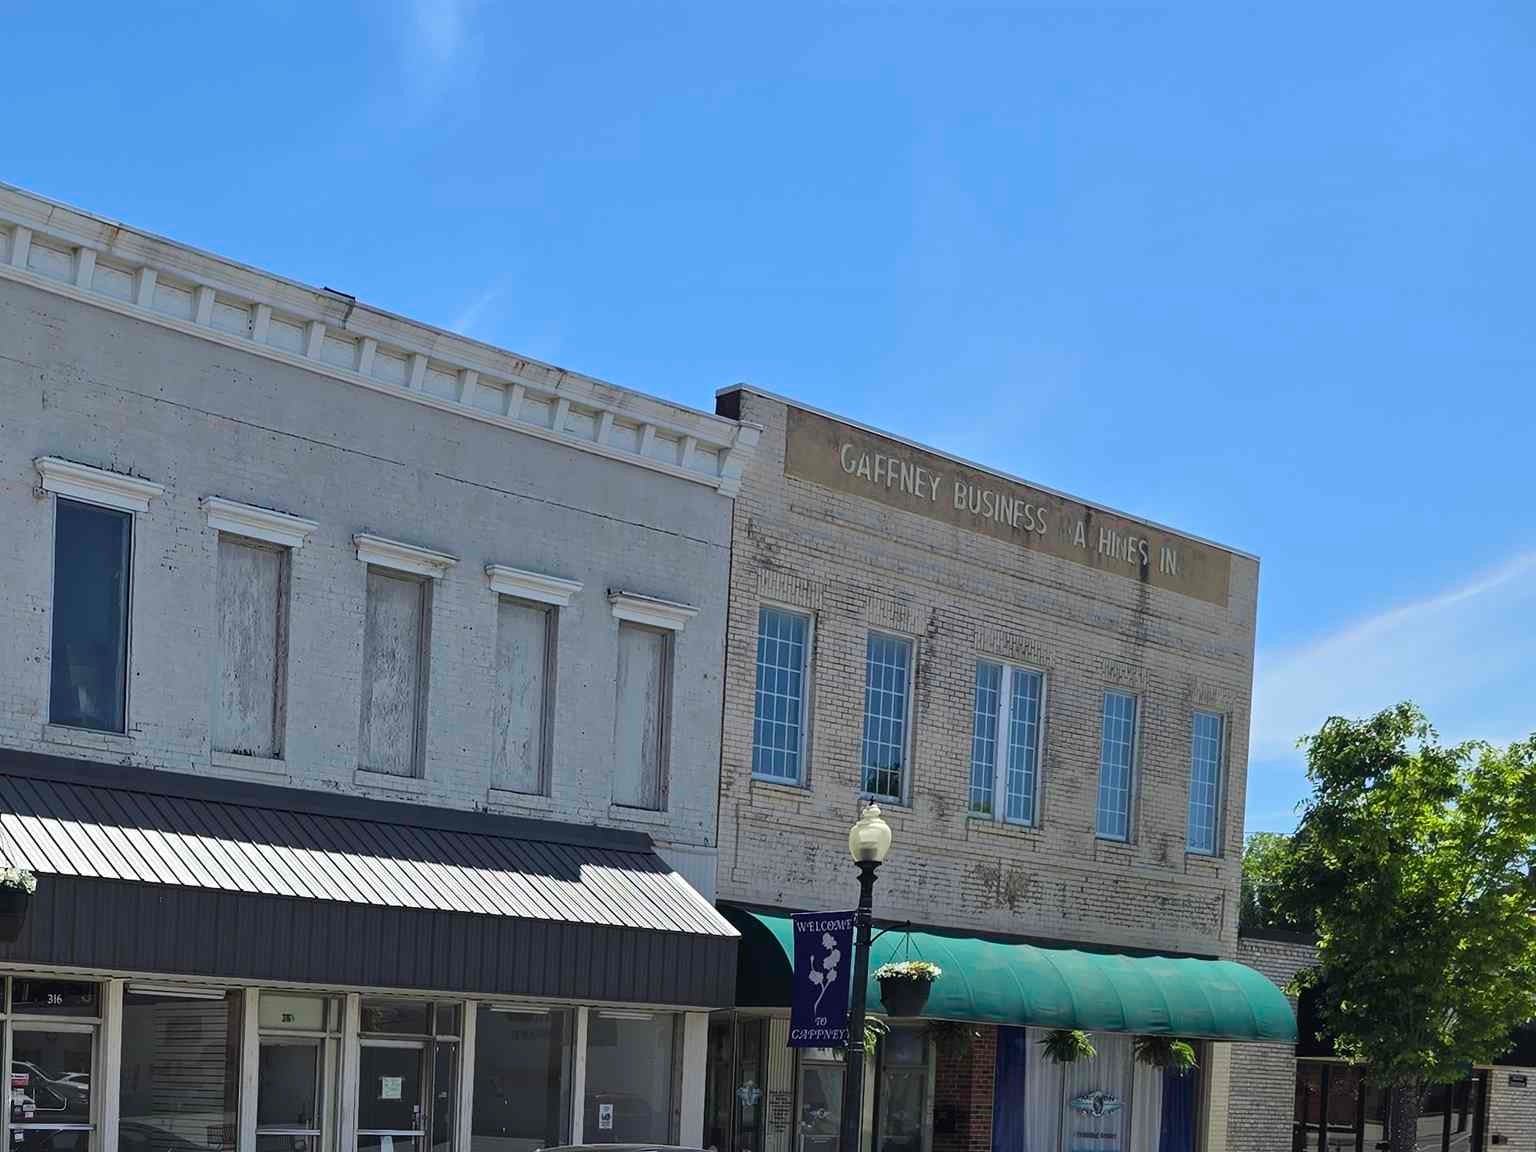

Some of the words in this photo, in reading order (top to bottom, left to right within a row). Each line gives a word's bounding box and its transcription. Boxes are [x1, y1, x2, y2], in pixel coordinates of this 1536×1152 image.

[840, 443, 941, 501] GAFFNEY
[953, 480, 1049, 535] BUSINESS
[796, 919, 853, 932] WELCOME
[47, 993, 63, 1005] 316
[814, 1016, 828, 1026] TO
